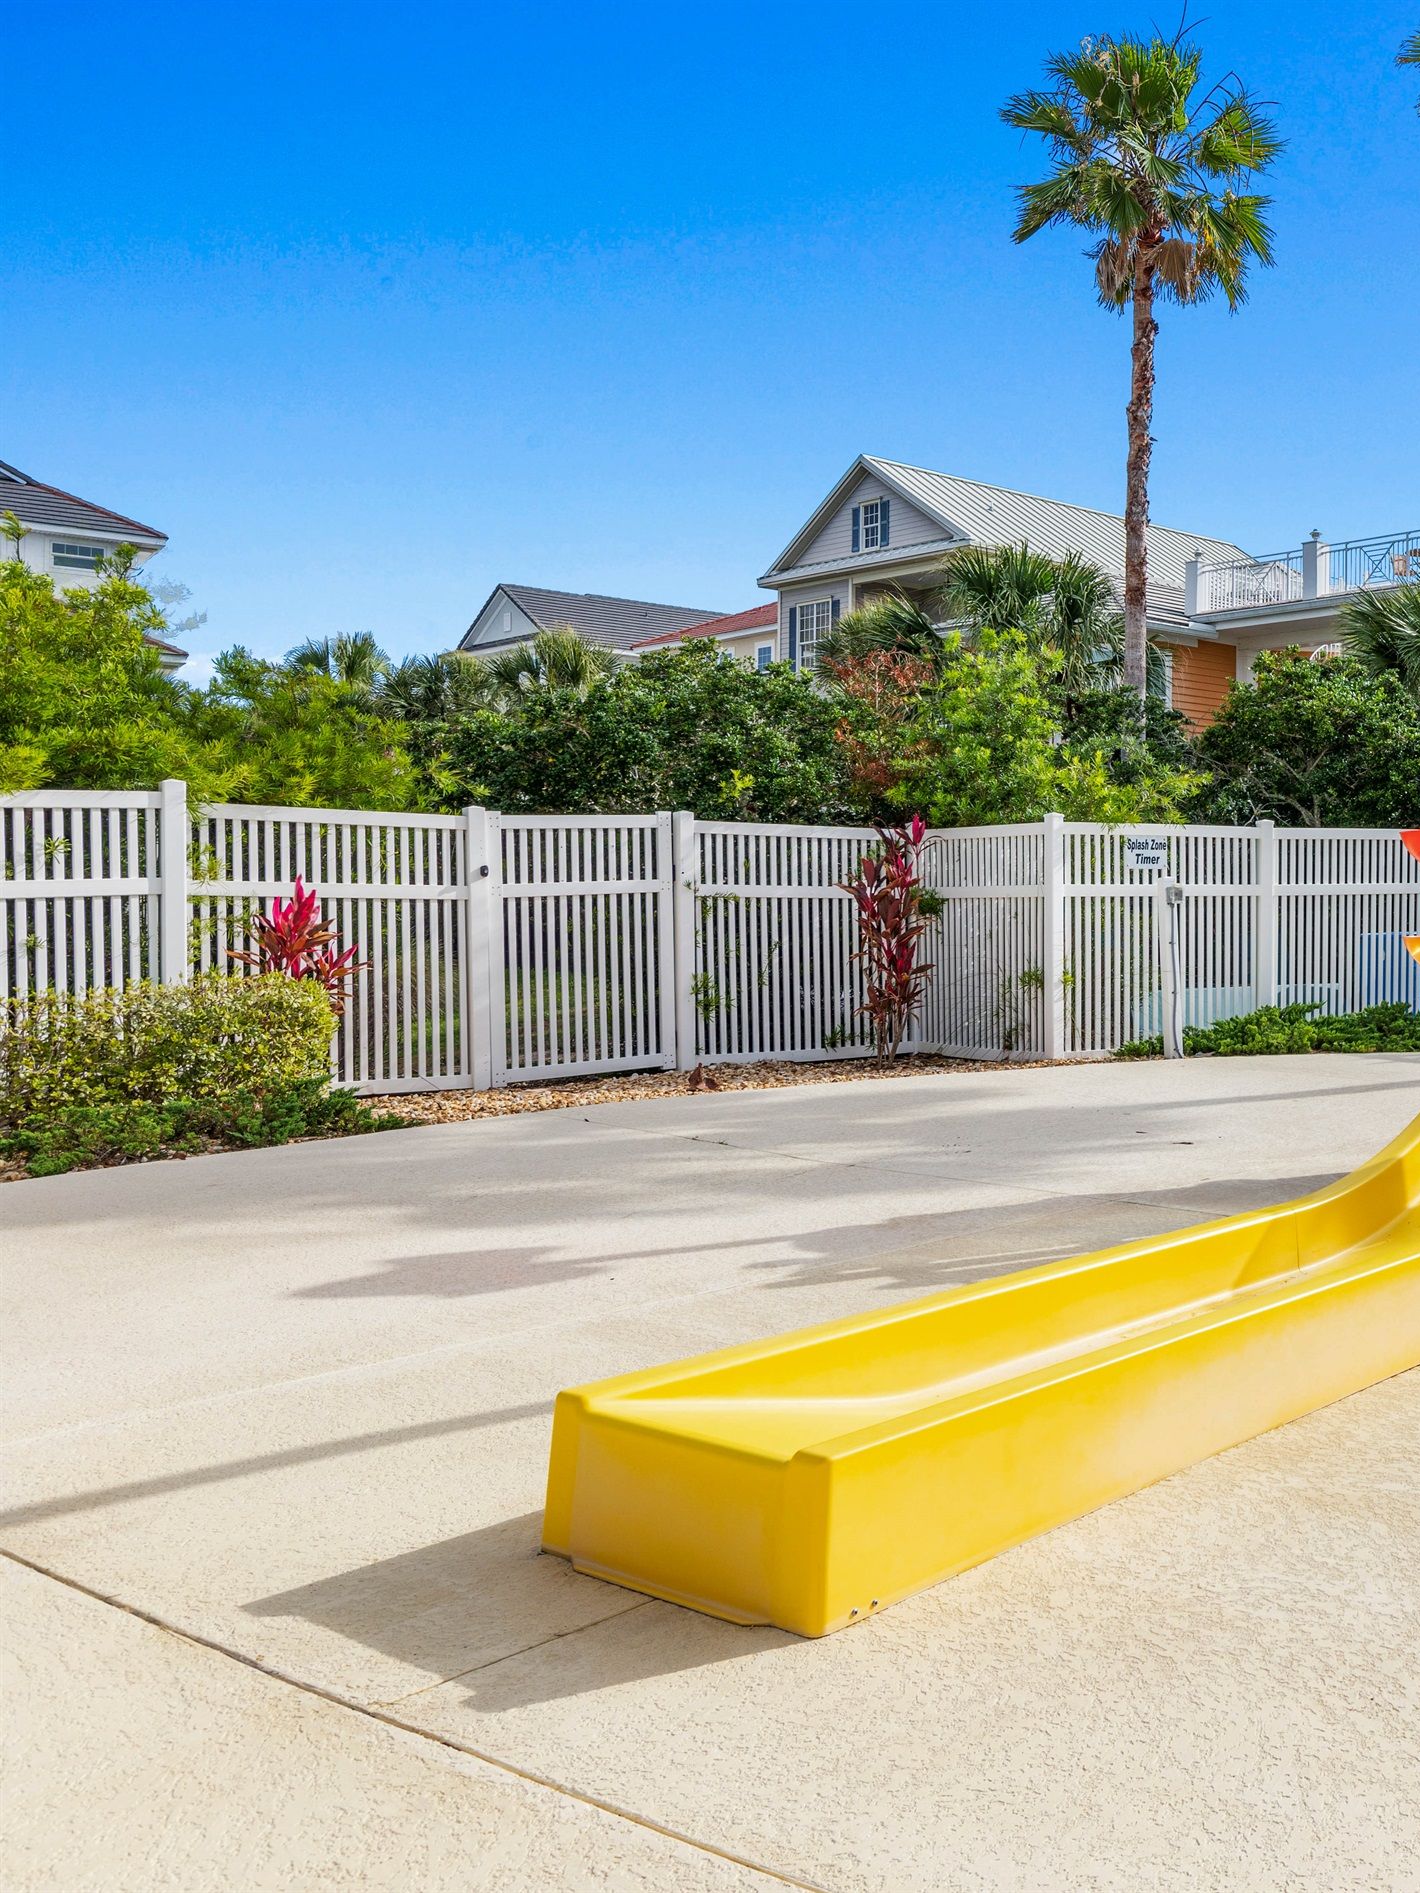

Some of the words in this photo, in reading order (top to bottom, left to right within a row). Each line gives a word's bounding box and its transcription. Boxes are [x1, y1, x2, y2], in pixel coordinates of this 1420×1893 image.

[1127, 839, 1149, 852] Splash
[1151, 839, 1166, 850] Zone
[1136, 854, 1160, 864] Timer
